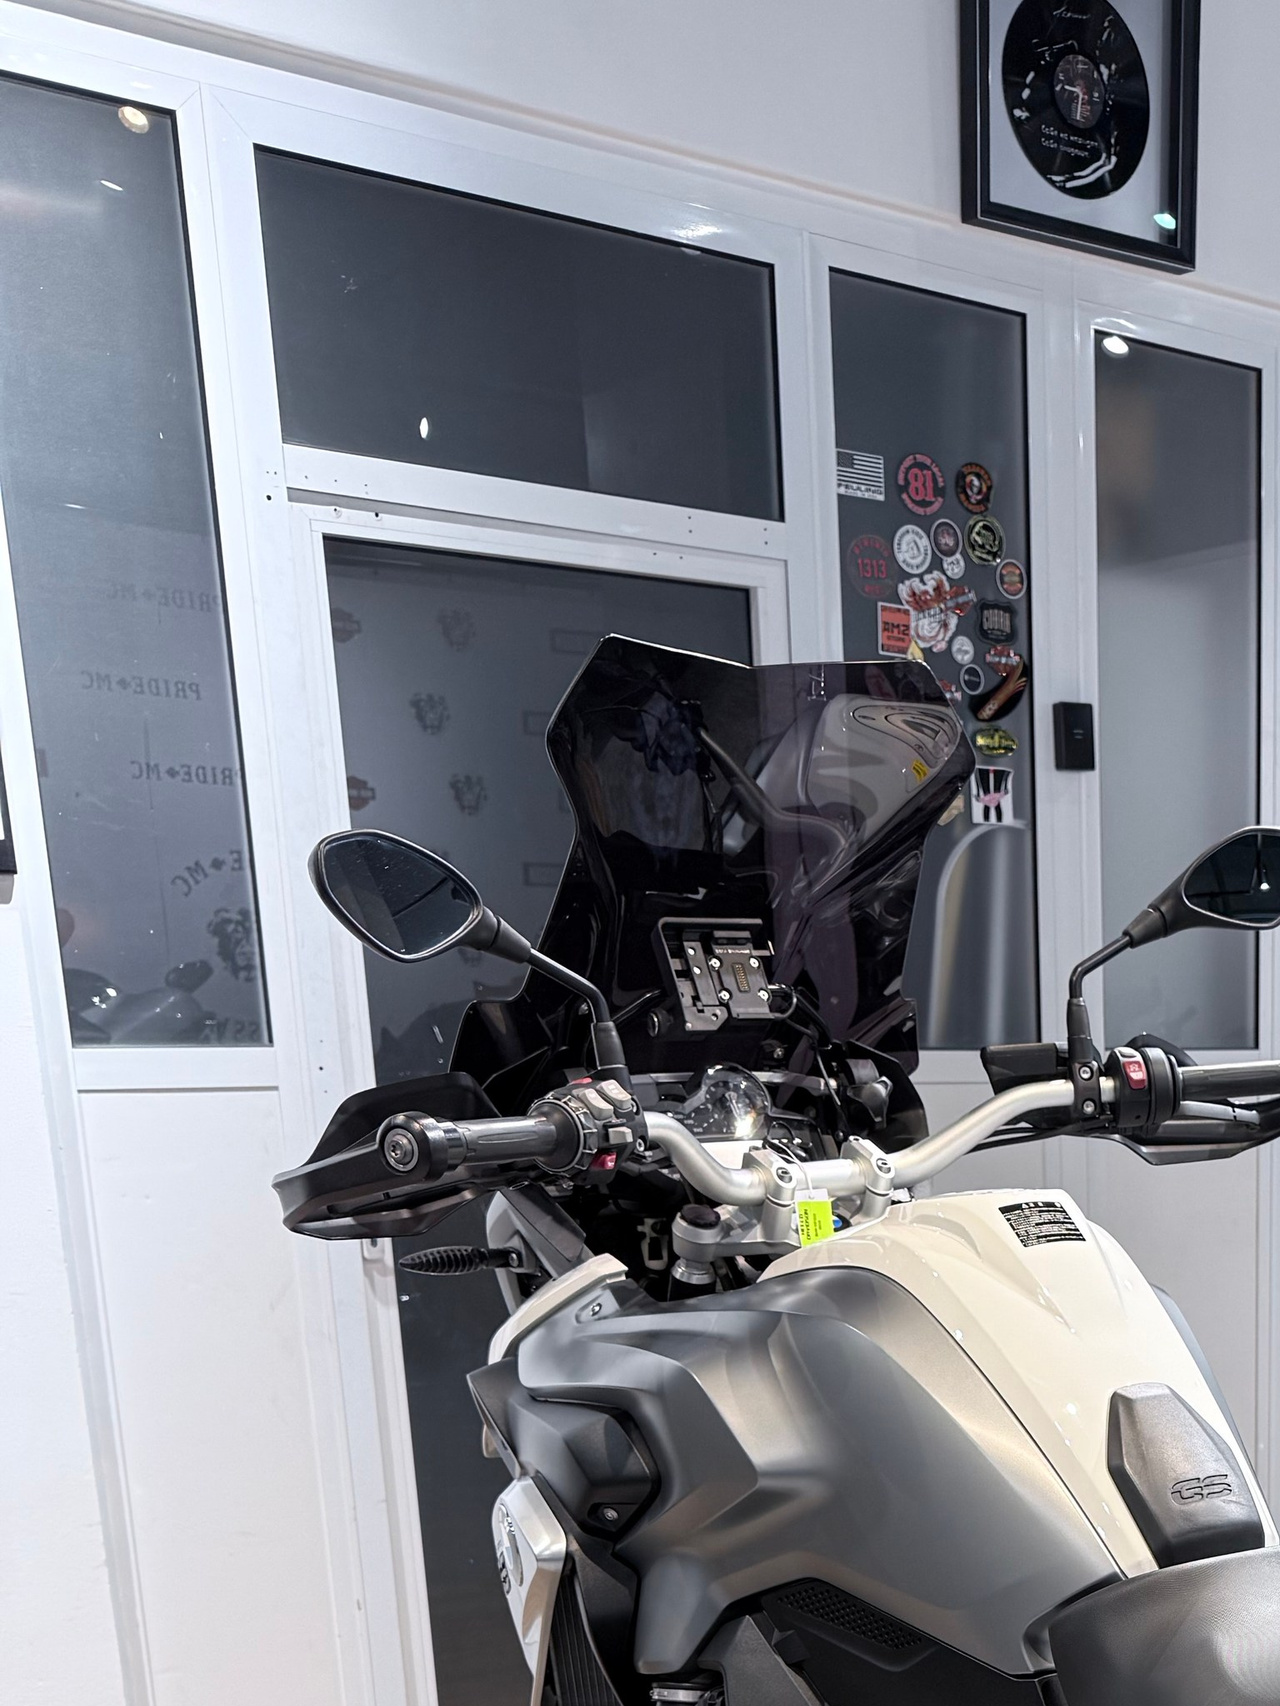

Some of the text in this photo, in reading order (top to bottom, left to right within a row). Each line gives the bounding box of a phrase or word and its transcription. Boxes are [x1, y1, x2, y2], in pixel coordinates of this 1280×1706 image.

[908, 468, 935, 500] 81
[858, 558, 888, 579] 1313
[1171, 1473, 1232, 1506] GS
